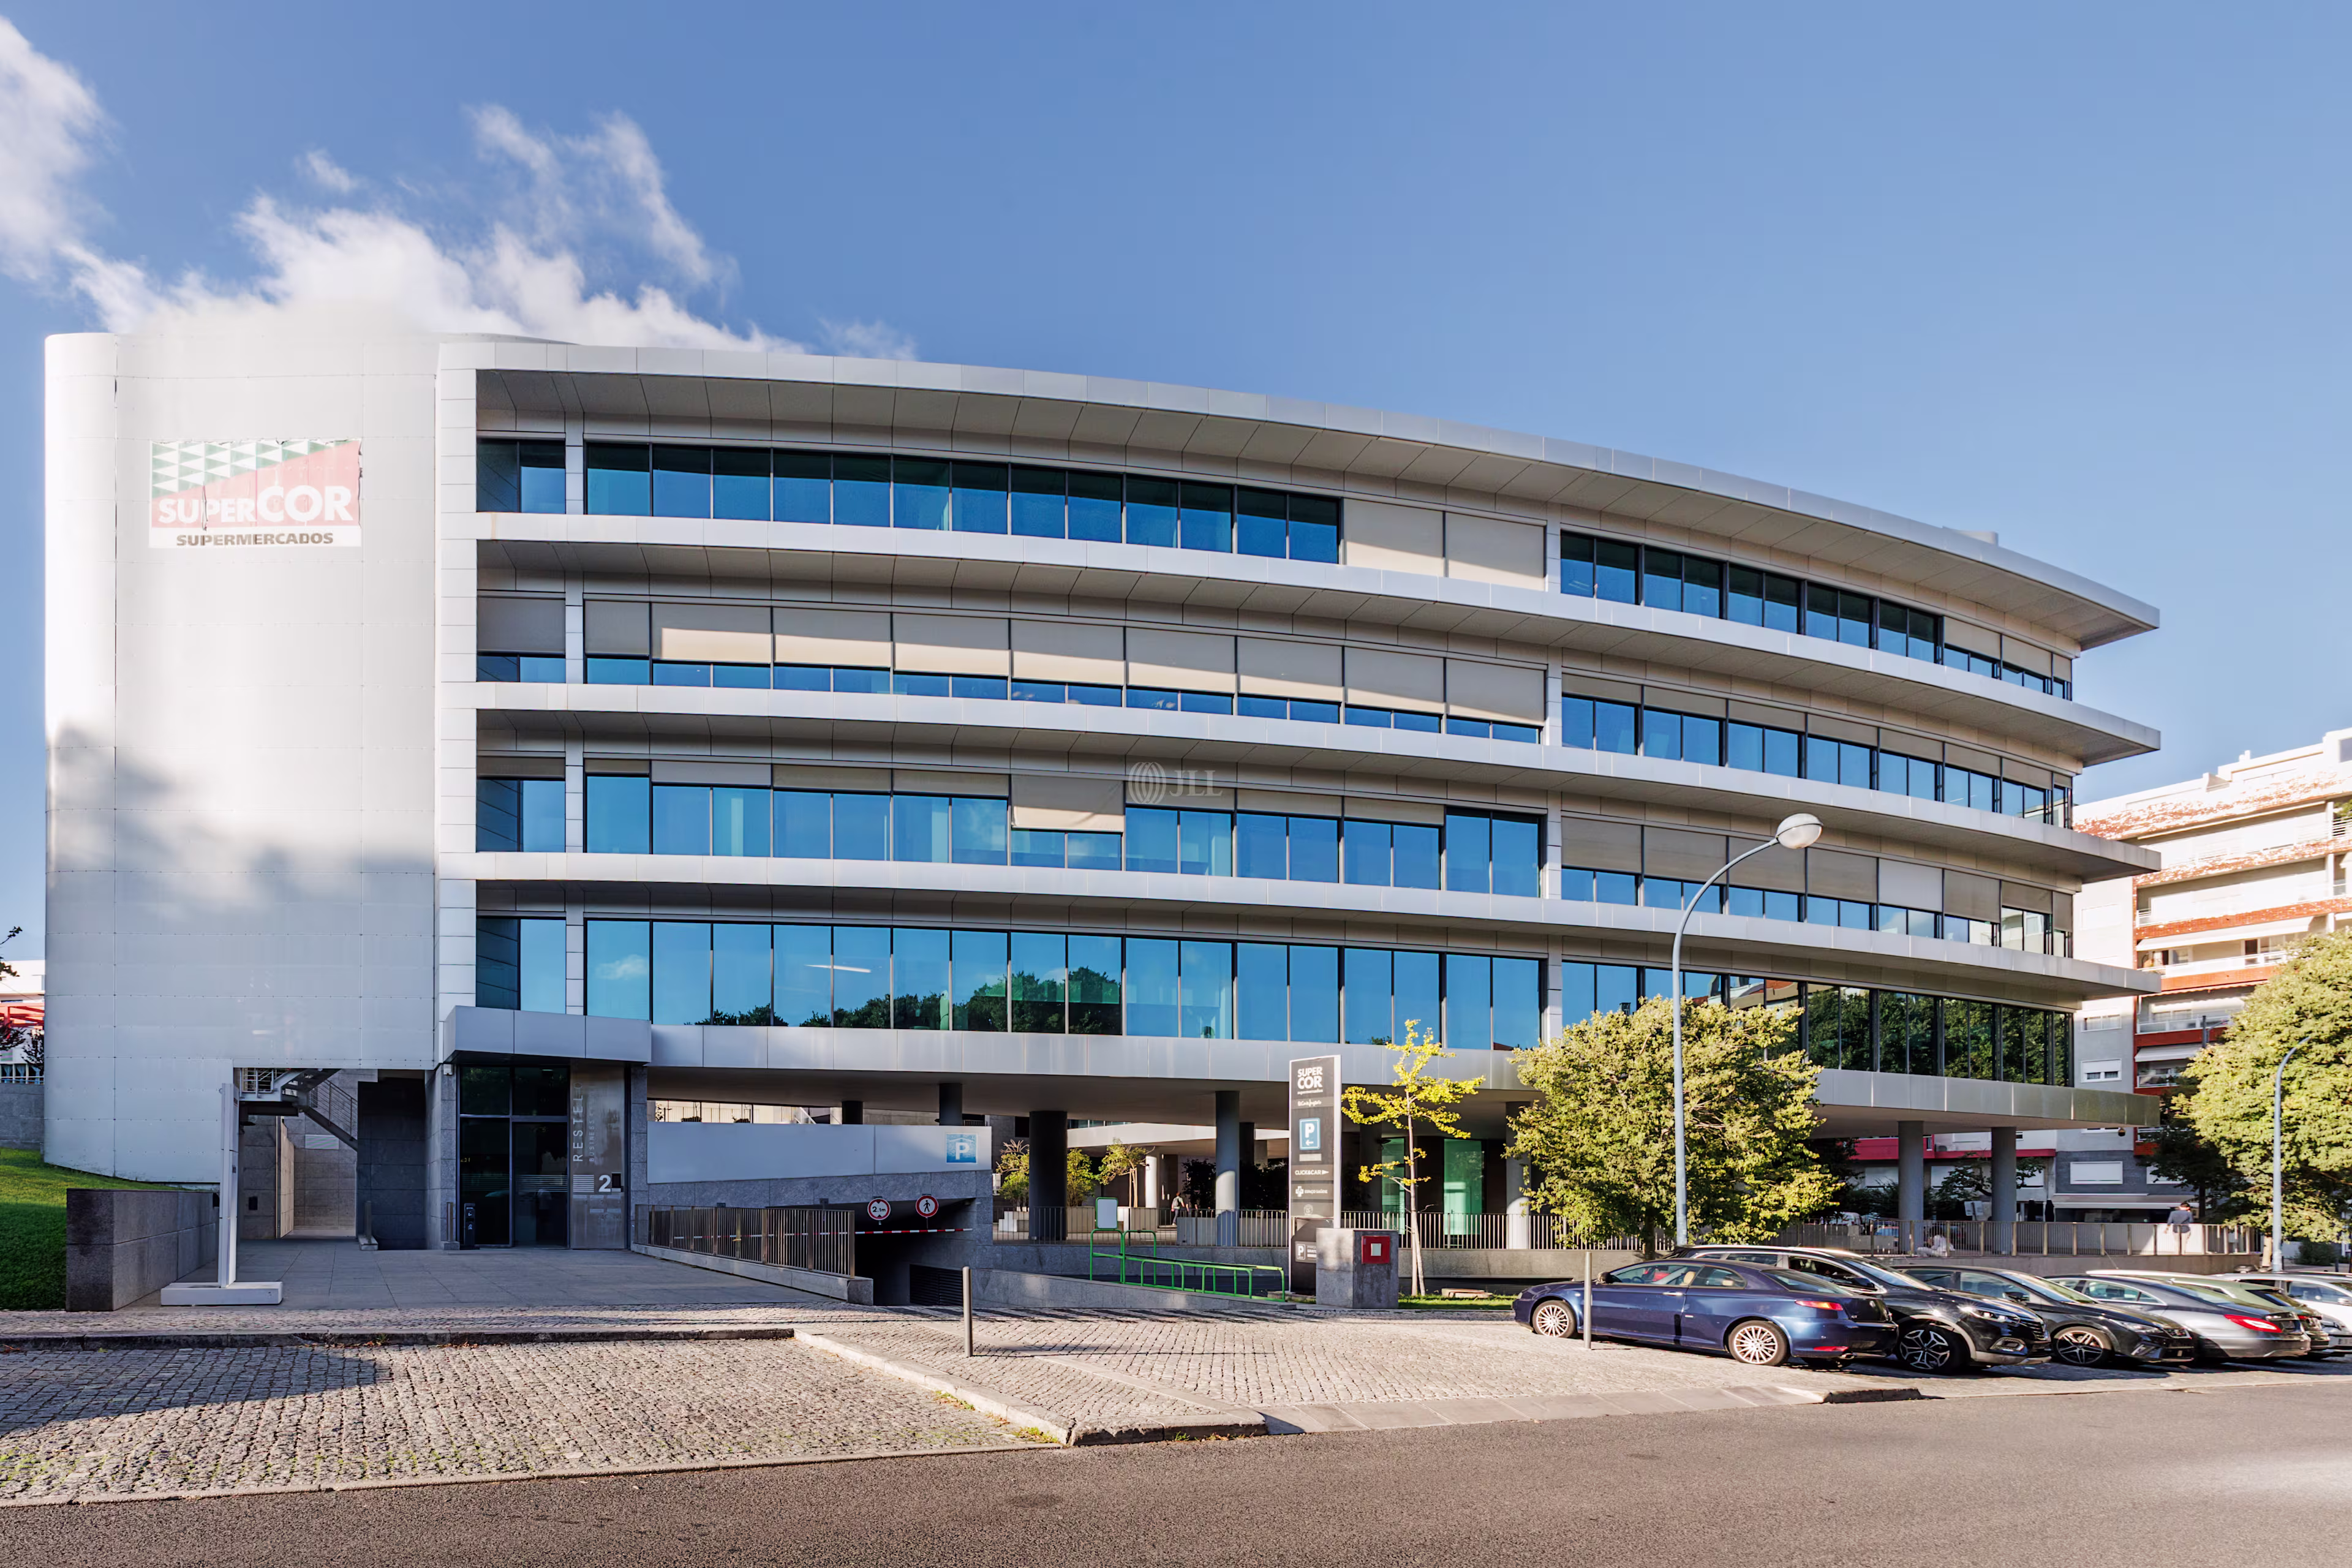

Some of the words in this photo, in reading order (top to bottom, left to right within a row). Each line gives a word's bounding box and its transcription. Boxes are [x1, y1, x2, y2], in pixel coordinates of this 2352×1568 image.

[176, 532, 334, 546] SUPERMERCADOS
[1297, 1066, 1323, 1077] SUPER
[1297, 1076, 1323, 1090] COR
[573, 1082, 584, 1162] RESTELO
[1305, 1123, 1315, 1138] P
[955, 1142, 970, 1160] P
[598, 1174, 611, 1193] 2
